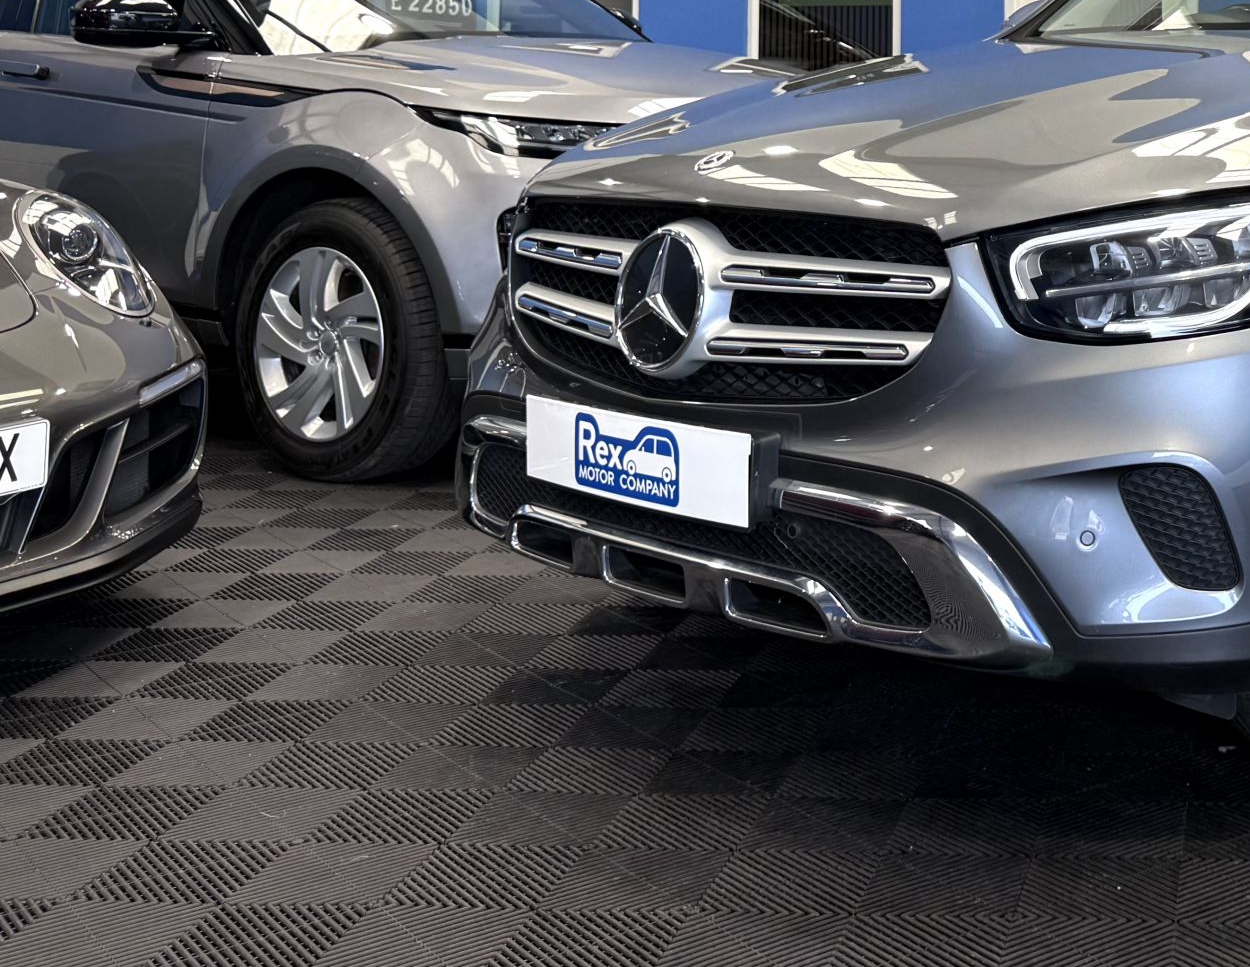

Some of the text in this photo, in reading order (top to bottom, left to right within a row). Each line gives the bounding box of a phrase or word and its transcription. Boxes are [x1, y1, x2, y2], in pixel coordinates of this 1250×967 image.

[578, 420, 623, 470] Rex
[578, 465, 676, 500] MOTOR COMPANY
